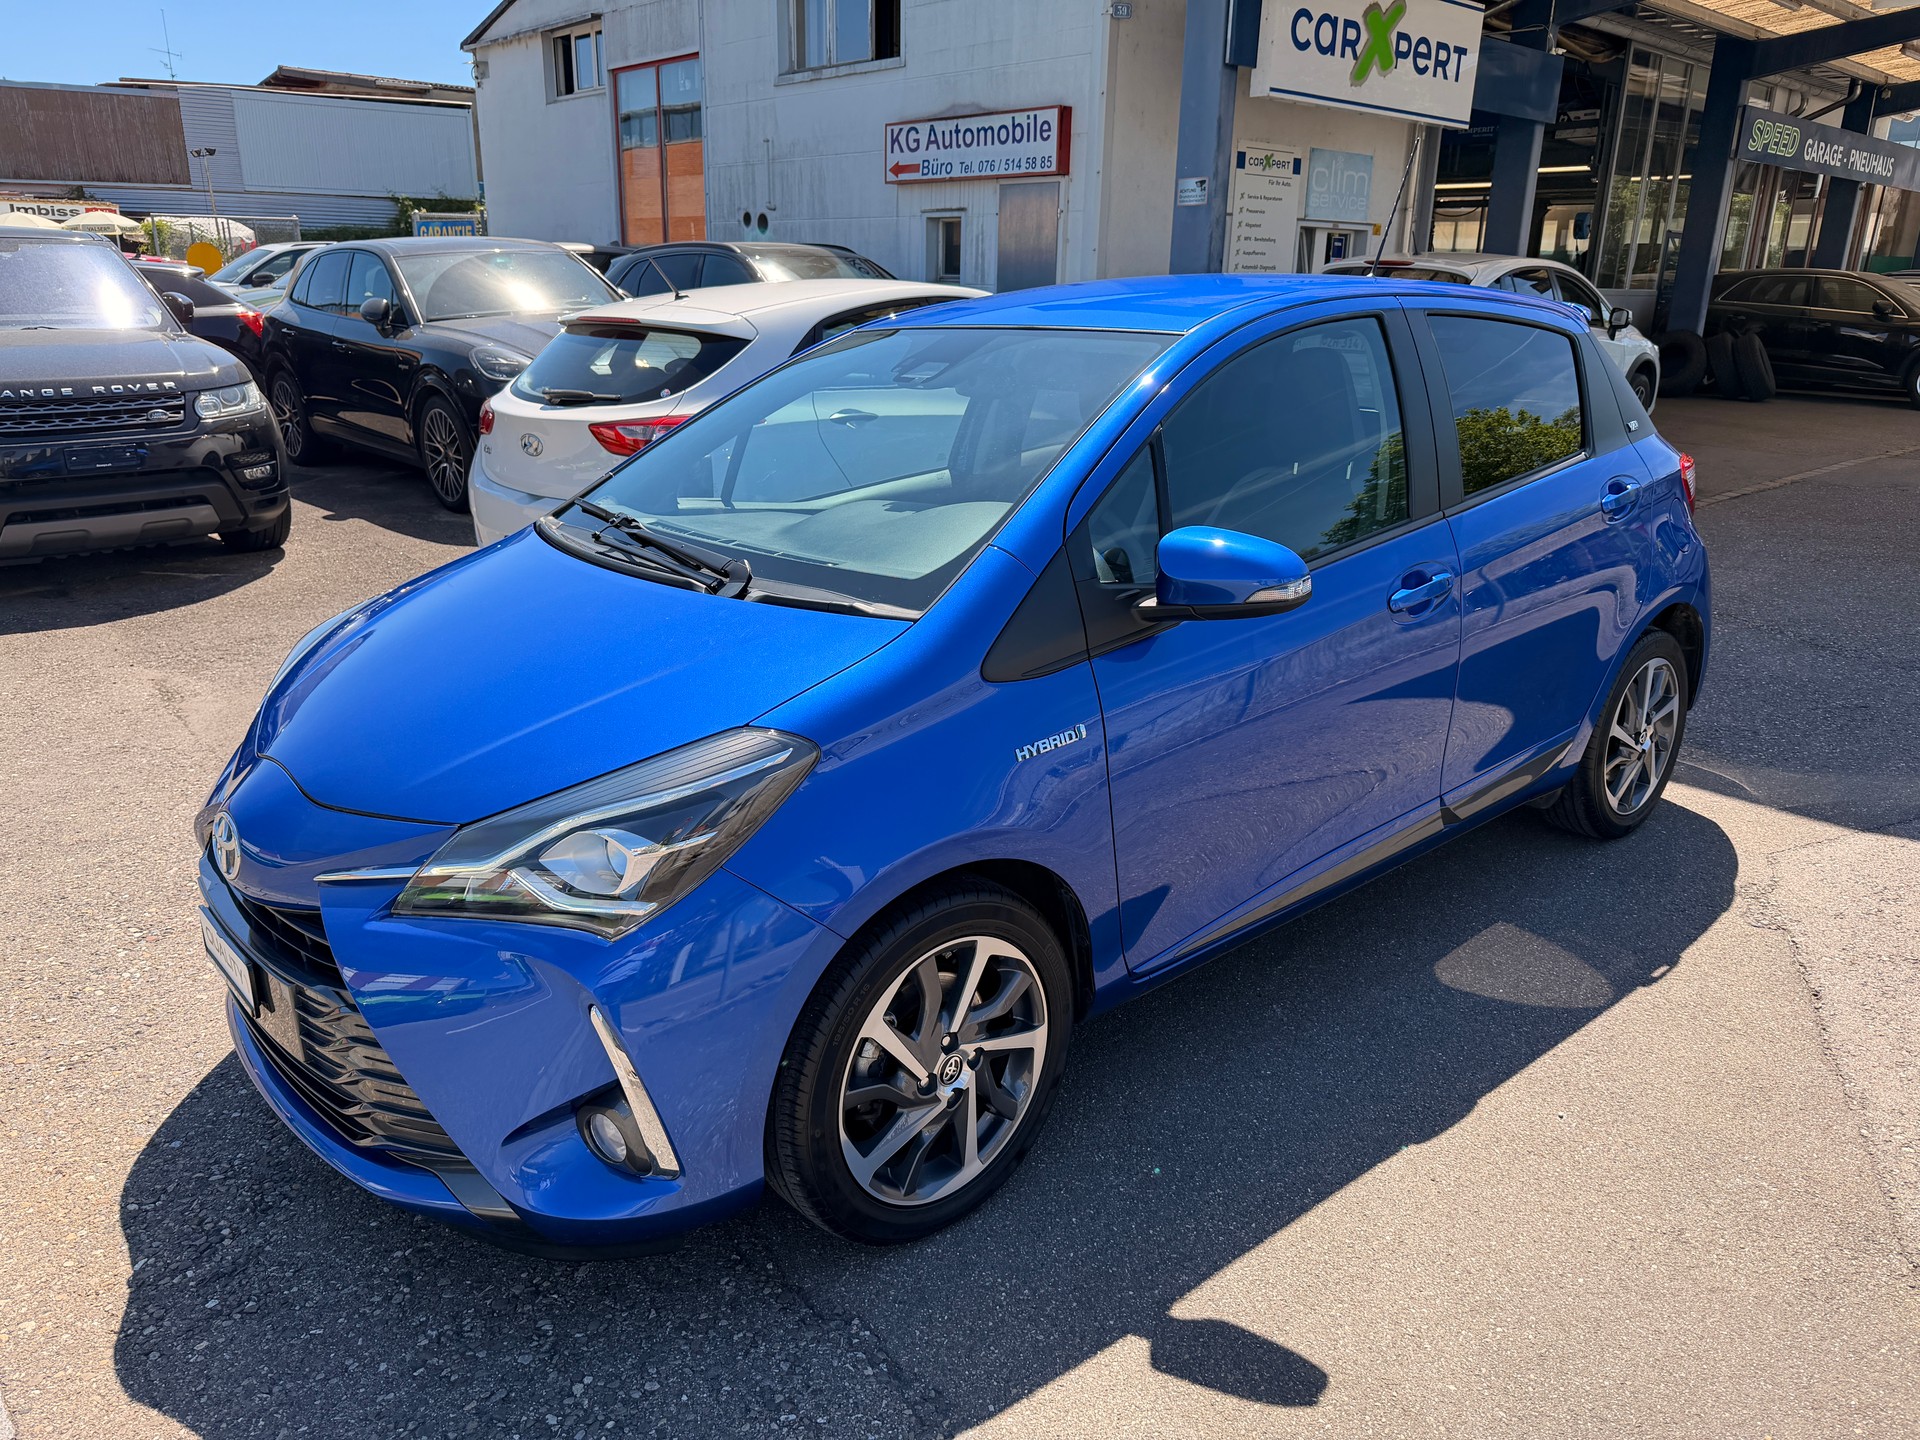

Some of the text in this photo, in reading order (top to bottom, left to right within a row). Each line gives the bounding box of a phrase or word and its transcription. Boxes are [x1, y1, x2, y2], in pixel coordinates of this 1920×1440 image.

[890, 114, 1052, 154] KG Automobile
[1747, 118, 1801, 158] SPEED
[1803, 138, 1843, 167] GARAGE
[1848, 149, 1895, 177] PNEUHAUS
[921, 158, 953, 177] Büro
[959, 161, 975, 174] Tel.
[978, 160, 996, 173] 076
[1004, 157, 1022, 172] 514
[1025, 156, 1037, 170] 58
[1039, 155, 1053, 169] 85
[1312, 157, 1368, 196] clim
[9, 203, 80, 218] Imbiss
[1310, 191, 1366, 210] service
[420, 225, 472, 237] GARANTIE
[92, 381, 178, 394] ROVER
[1015, 728, 1080, 763] HYBRID
